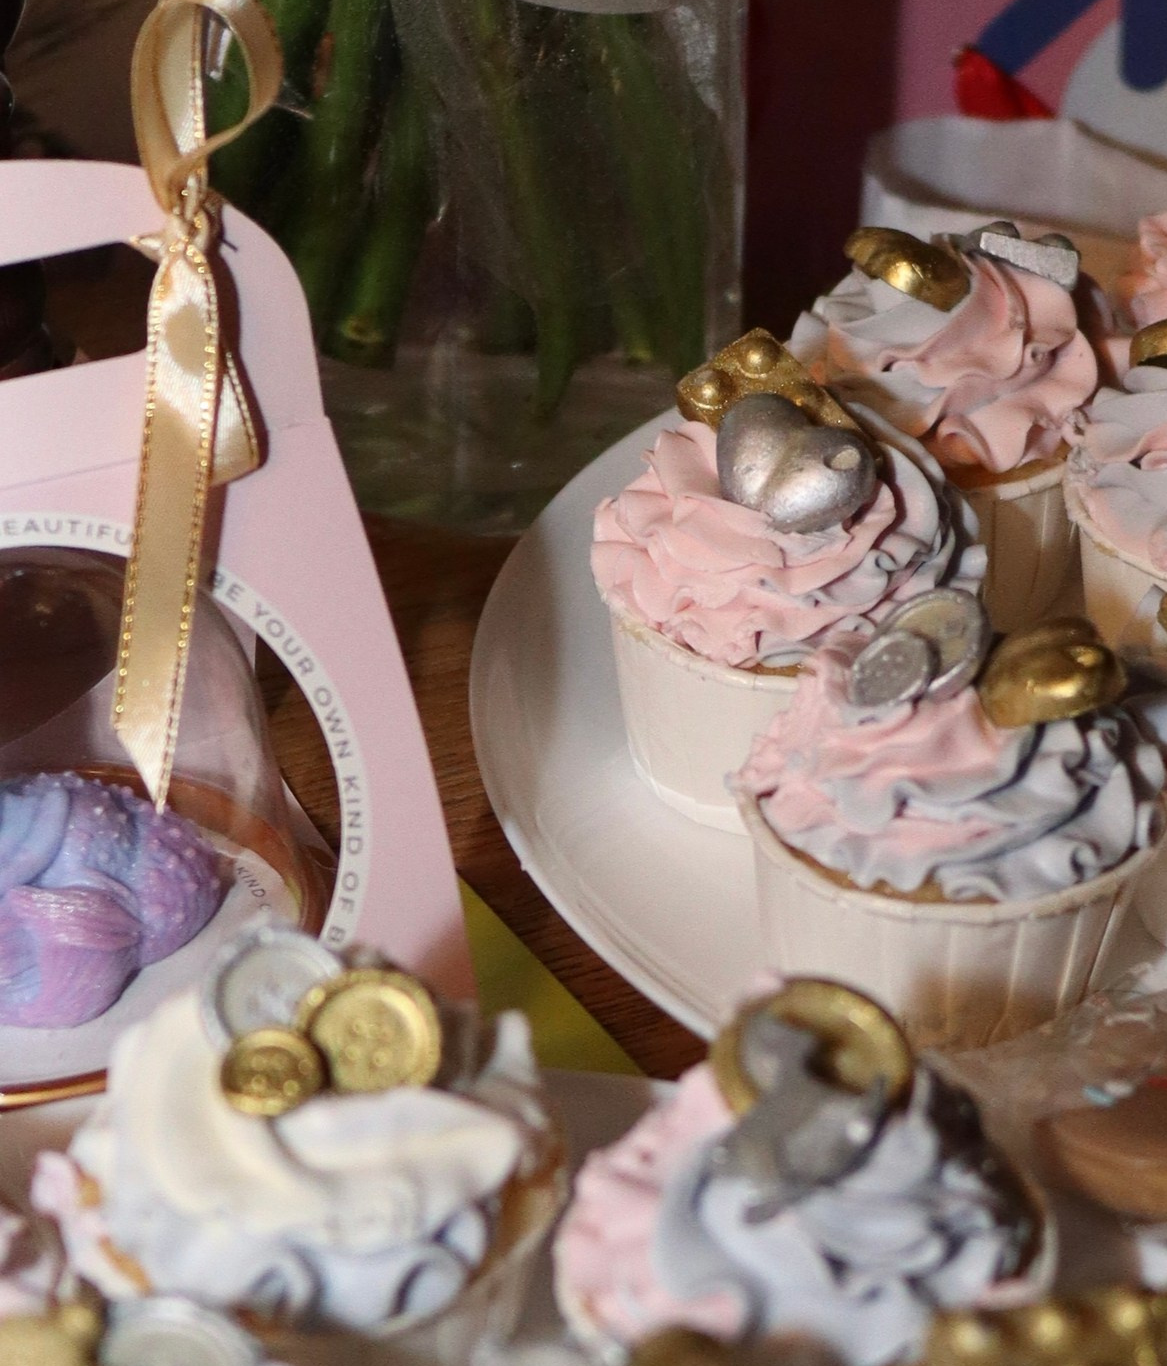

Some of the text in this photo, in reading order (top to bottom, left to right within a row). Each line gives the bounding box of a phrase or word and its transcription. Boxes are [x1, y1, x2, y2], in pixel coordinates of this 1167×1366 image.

[2, 517, 135, 546] EAUTIFU
[254, 602, 315, 677] YOUR
[314, 687, 353, 759] OWN
[343, 775, 364, 855] KIND
[236, 866, 266, 898] KIND
[338, 871, 359, 913] OF
